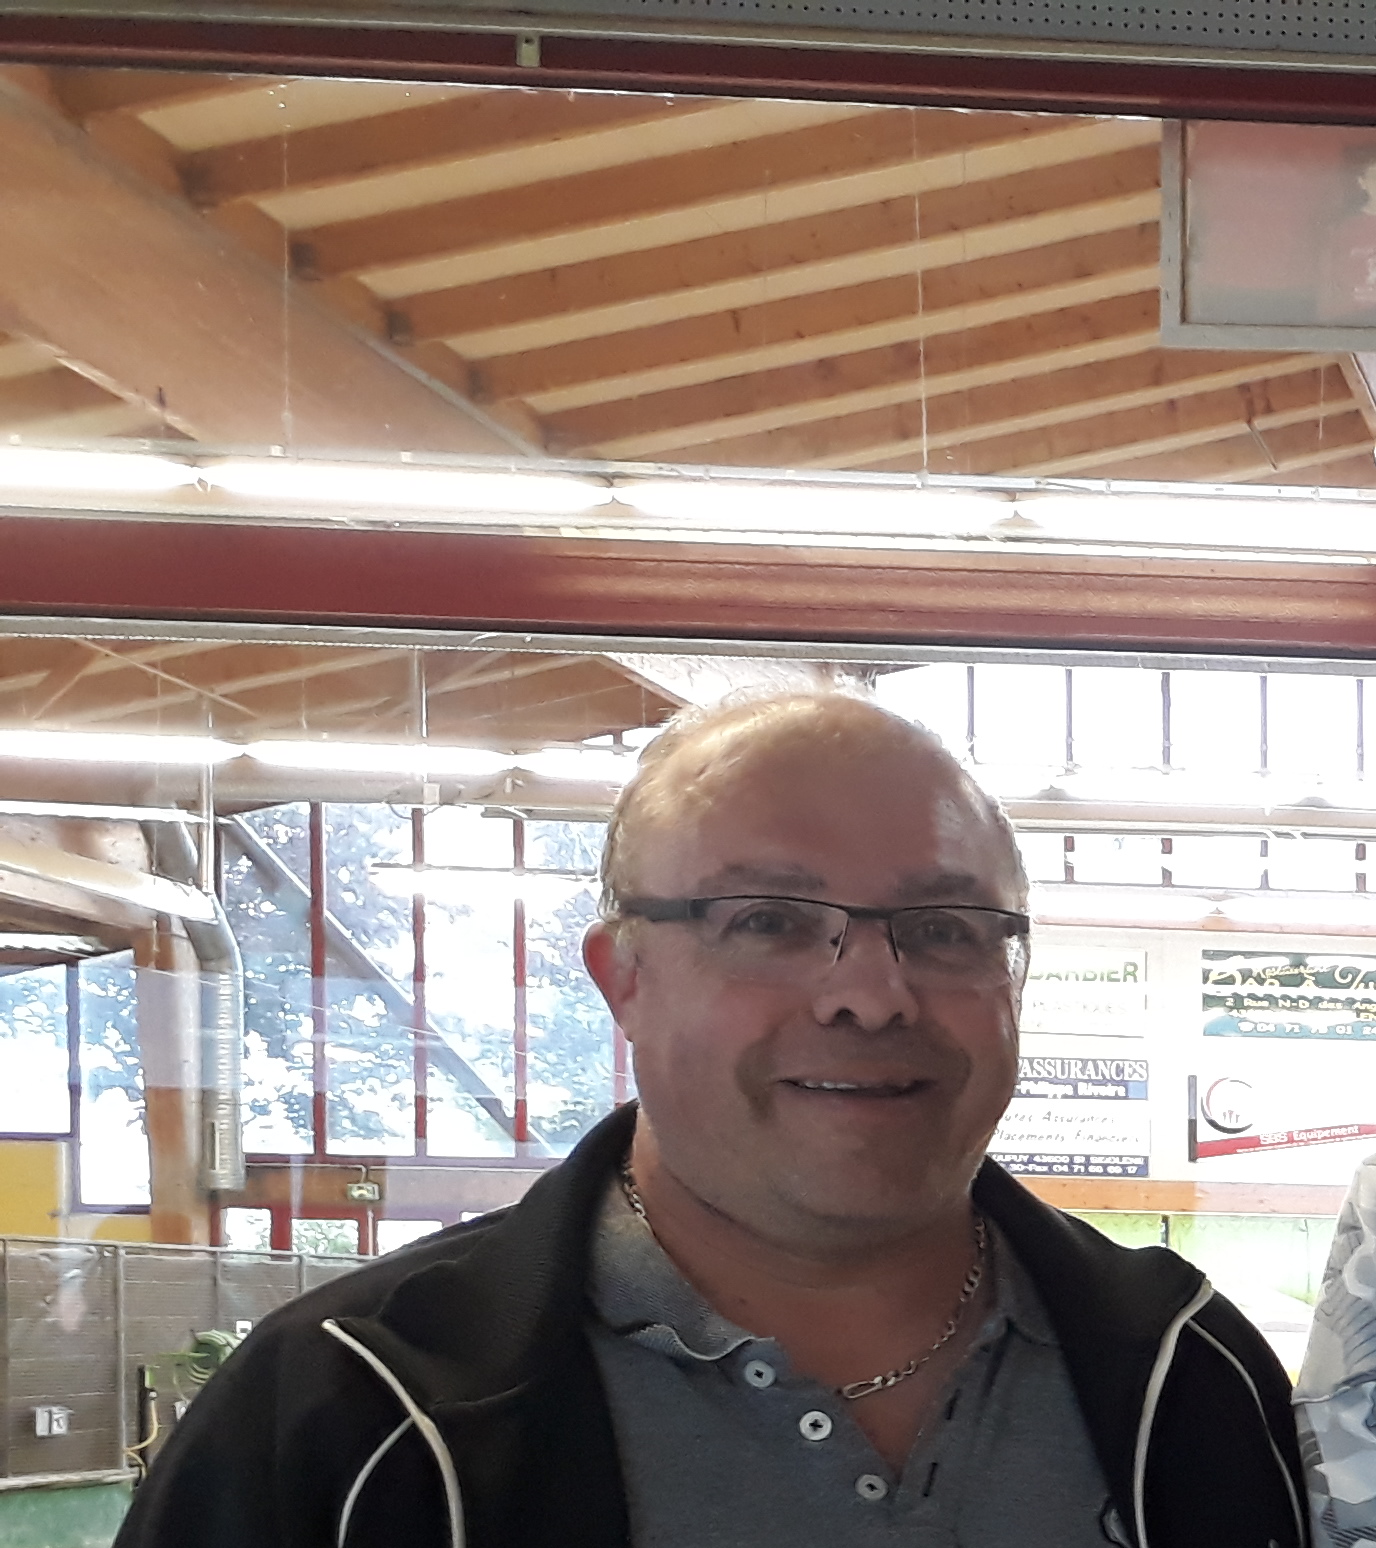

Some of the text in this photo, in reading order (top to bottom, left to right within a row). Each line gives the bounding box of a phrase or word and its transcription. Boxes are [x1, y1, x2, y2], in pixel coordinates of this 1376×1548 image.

[1243, 998, 1270, 1008] Rue
[1277, 999, 1310, 1009] N-D
[1292, 1124, 1360, 1142] Equipement
